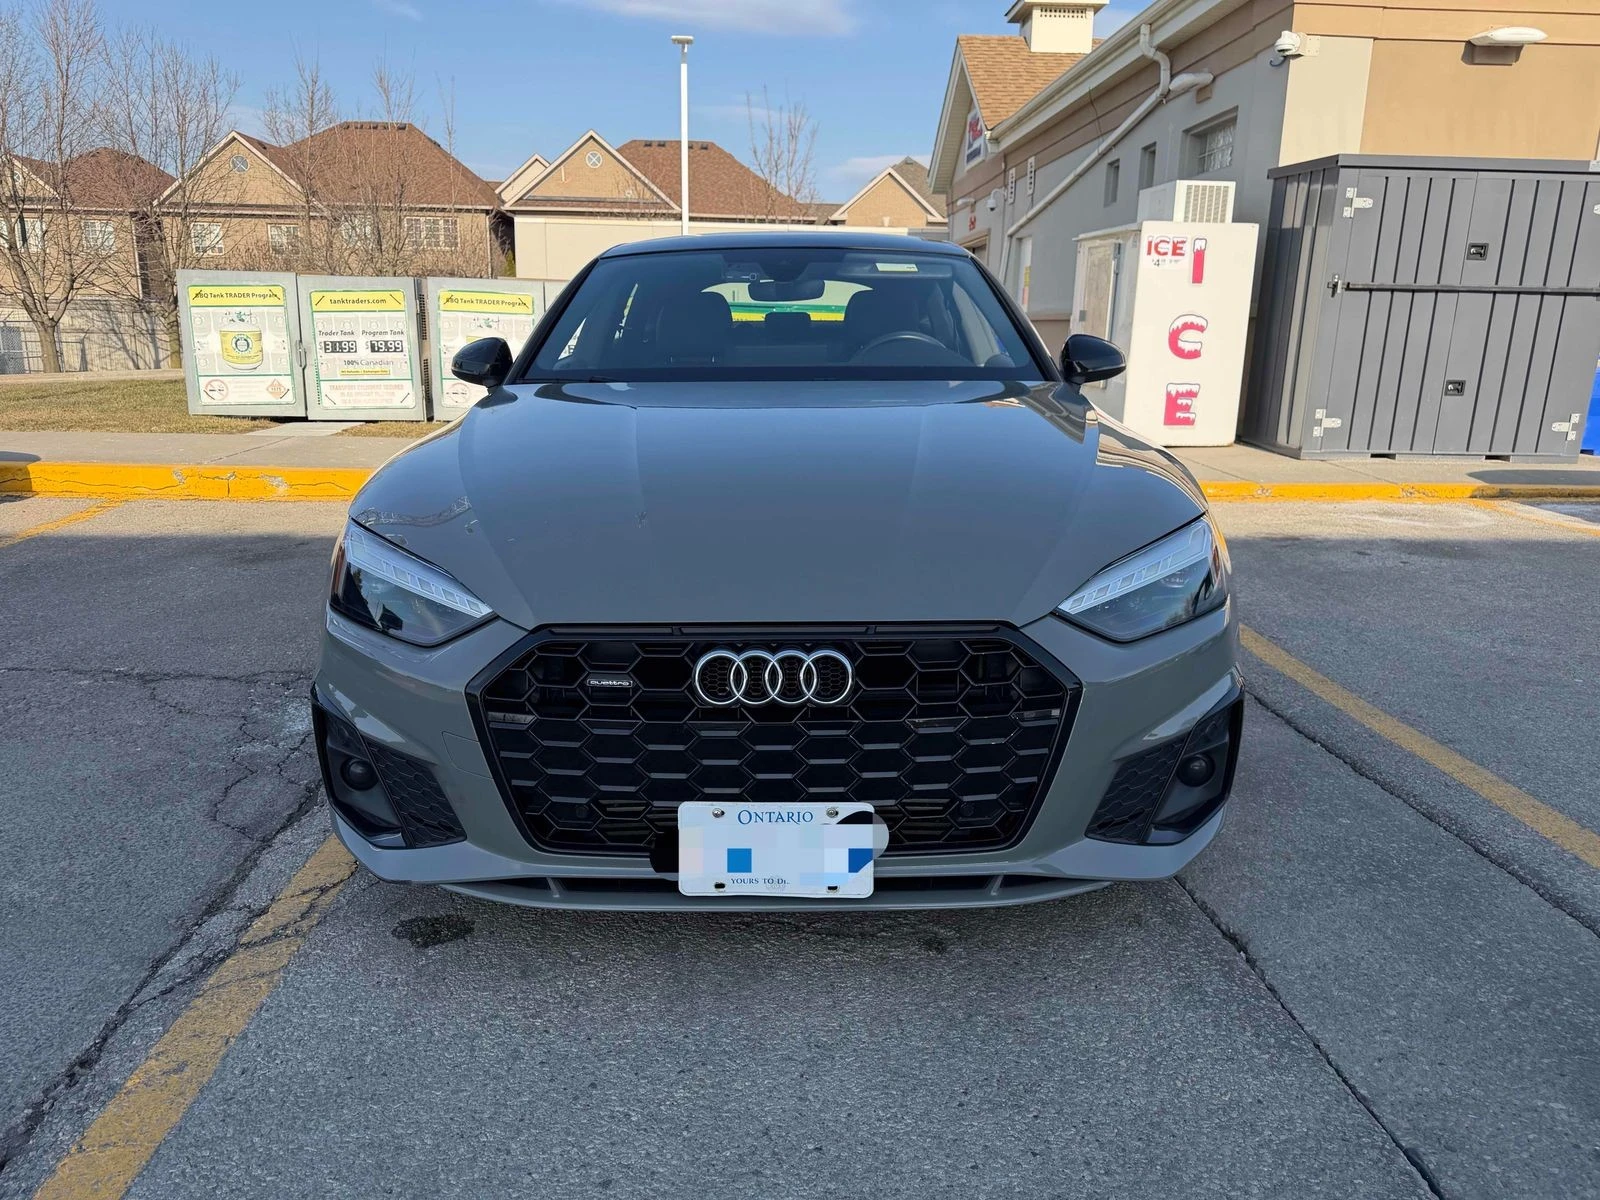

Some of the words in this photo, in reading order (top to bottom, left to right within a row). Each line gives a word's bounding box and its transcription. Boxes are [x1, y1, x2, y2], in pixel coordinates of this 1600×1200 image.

[1147, 235, 1187, 256] ICE
[1163, 237, 1208, 426] ICE
[737, 809, 814, 825] ONTARIO
[730, 877, 759, 885] YOURS
[762, 877, 775, 885] TO
